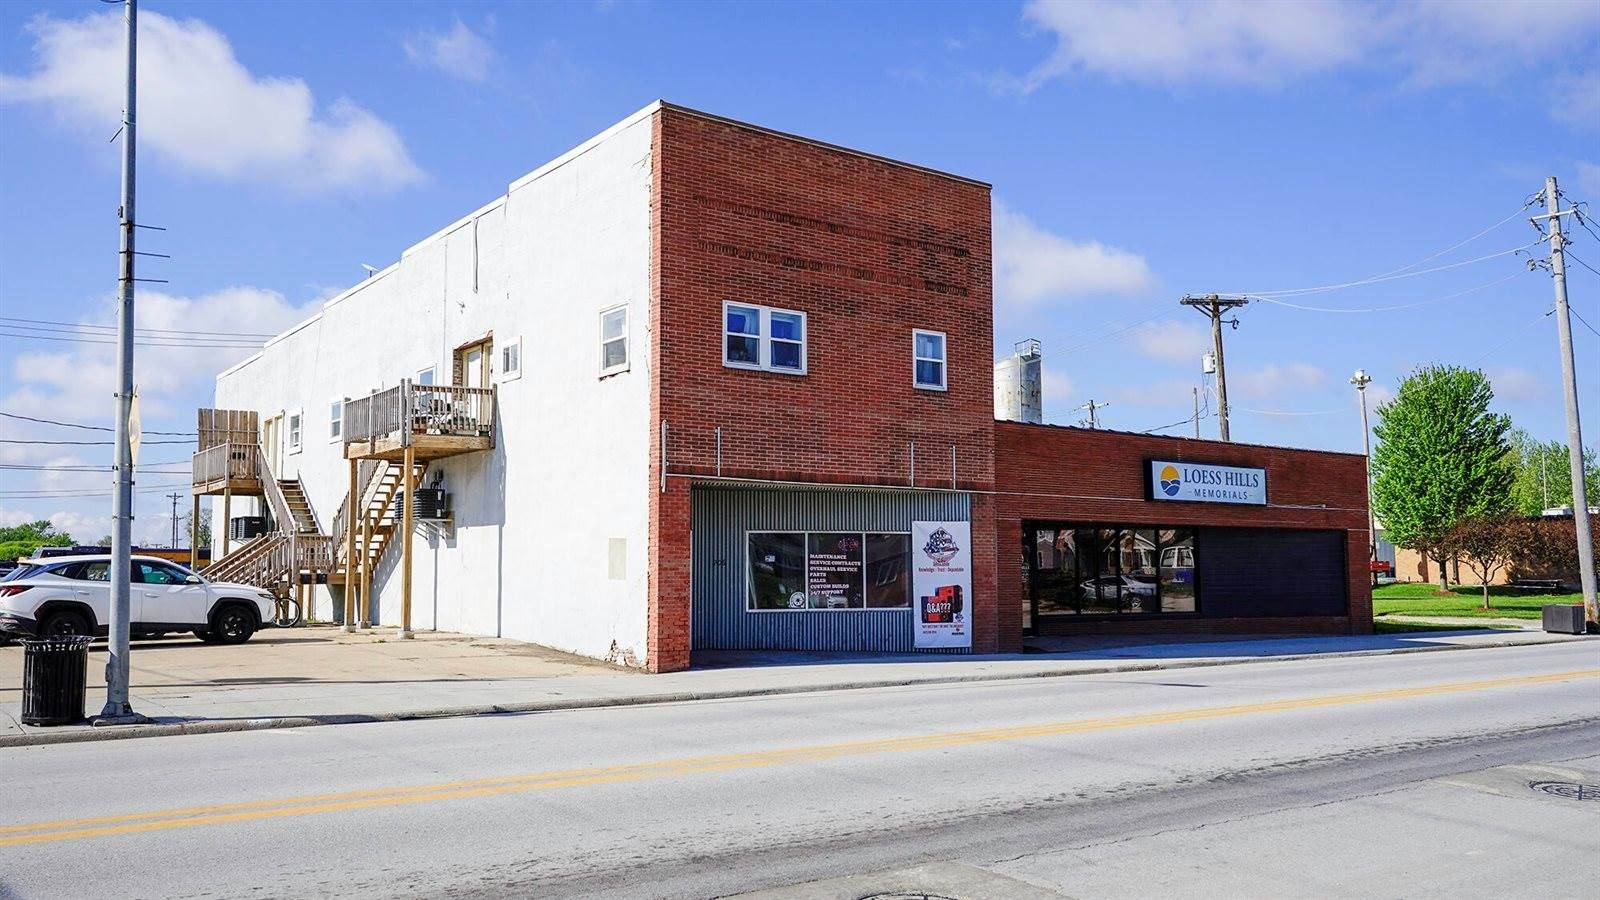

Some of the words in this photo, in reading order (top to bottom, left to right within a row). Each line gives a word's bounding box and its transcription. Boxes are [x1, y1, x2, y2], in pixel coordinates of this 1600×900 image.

[1184, 469, 1221, 485] LOESS
[1225, 472, 1258, 488] HILLS
[1194, 489, 1248, 500] MEMORIALS
[927, 603, 950, 613] Q&A???
